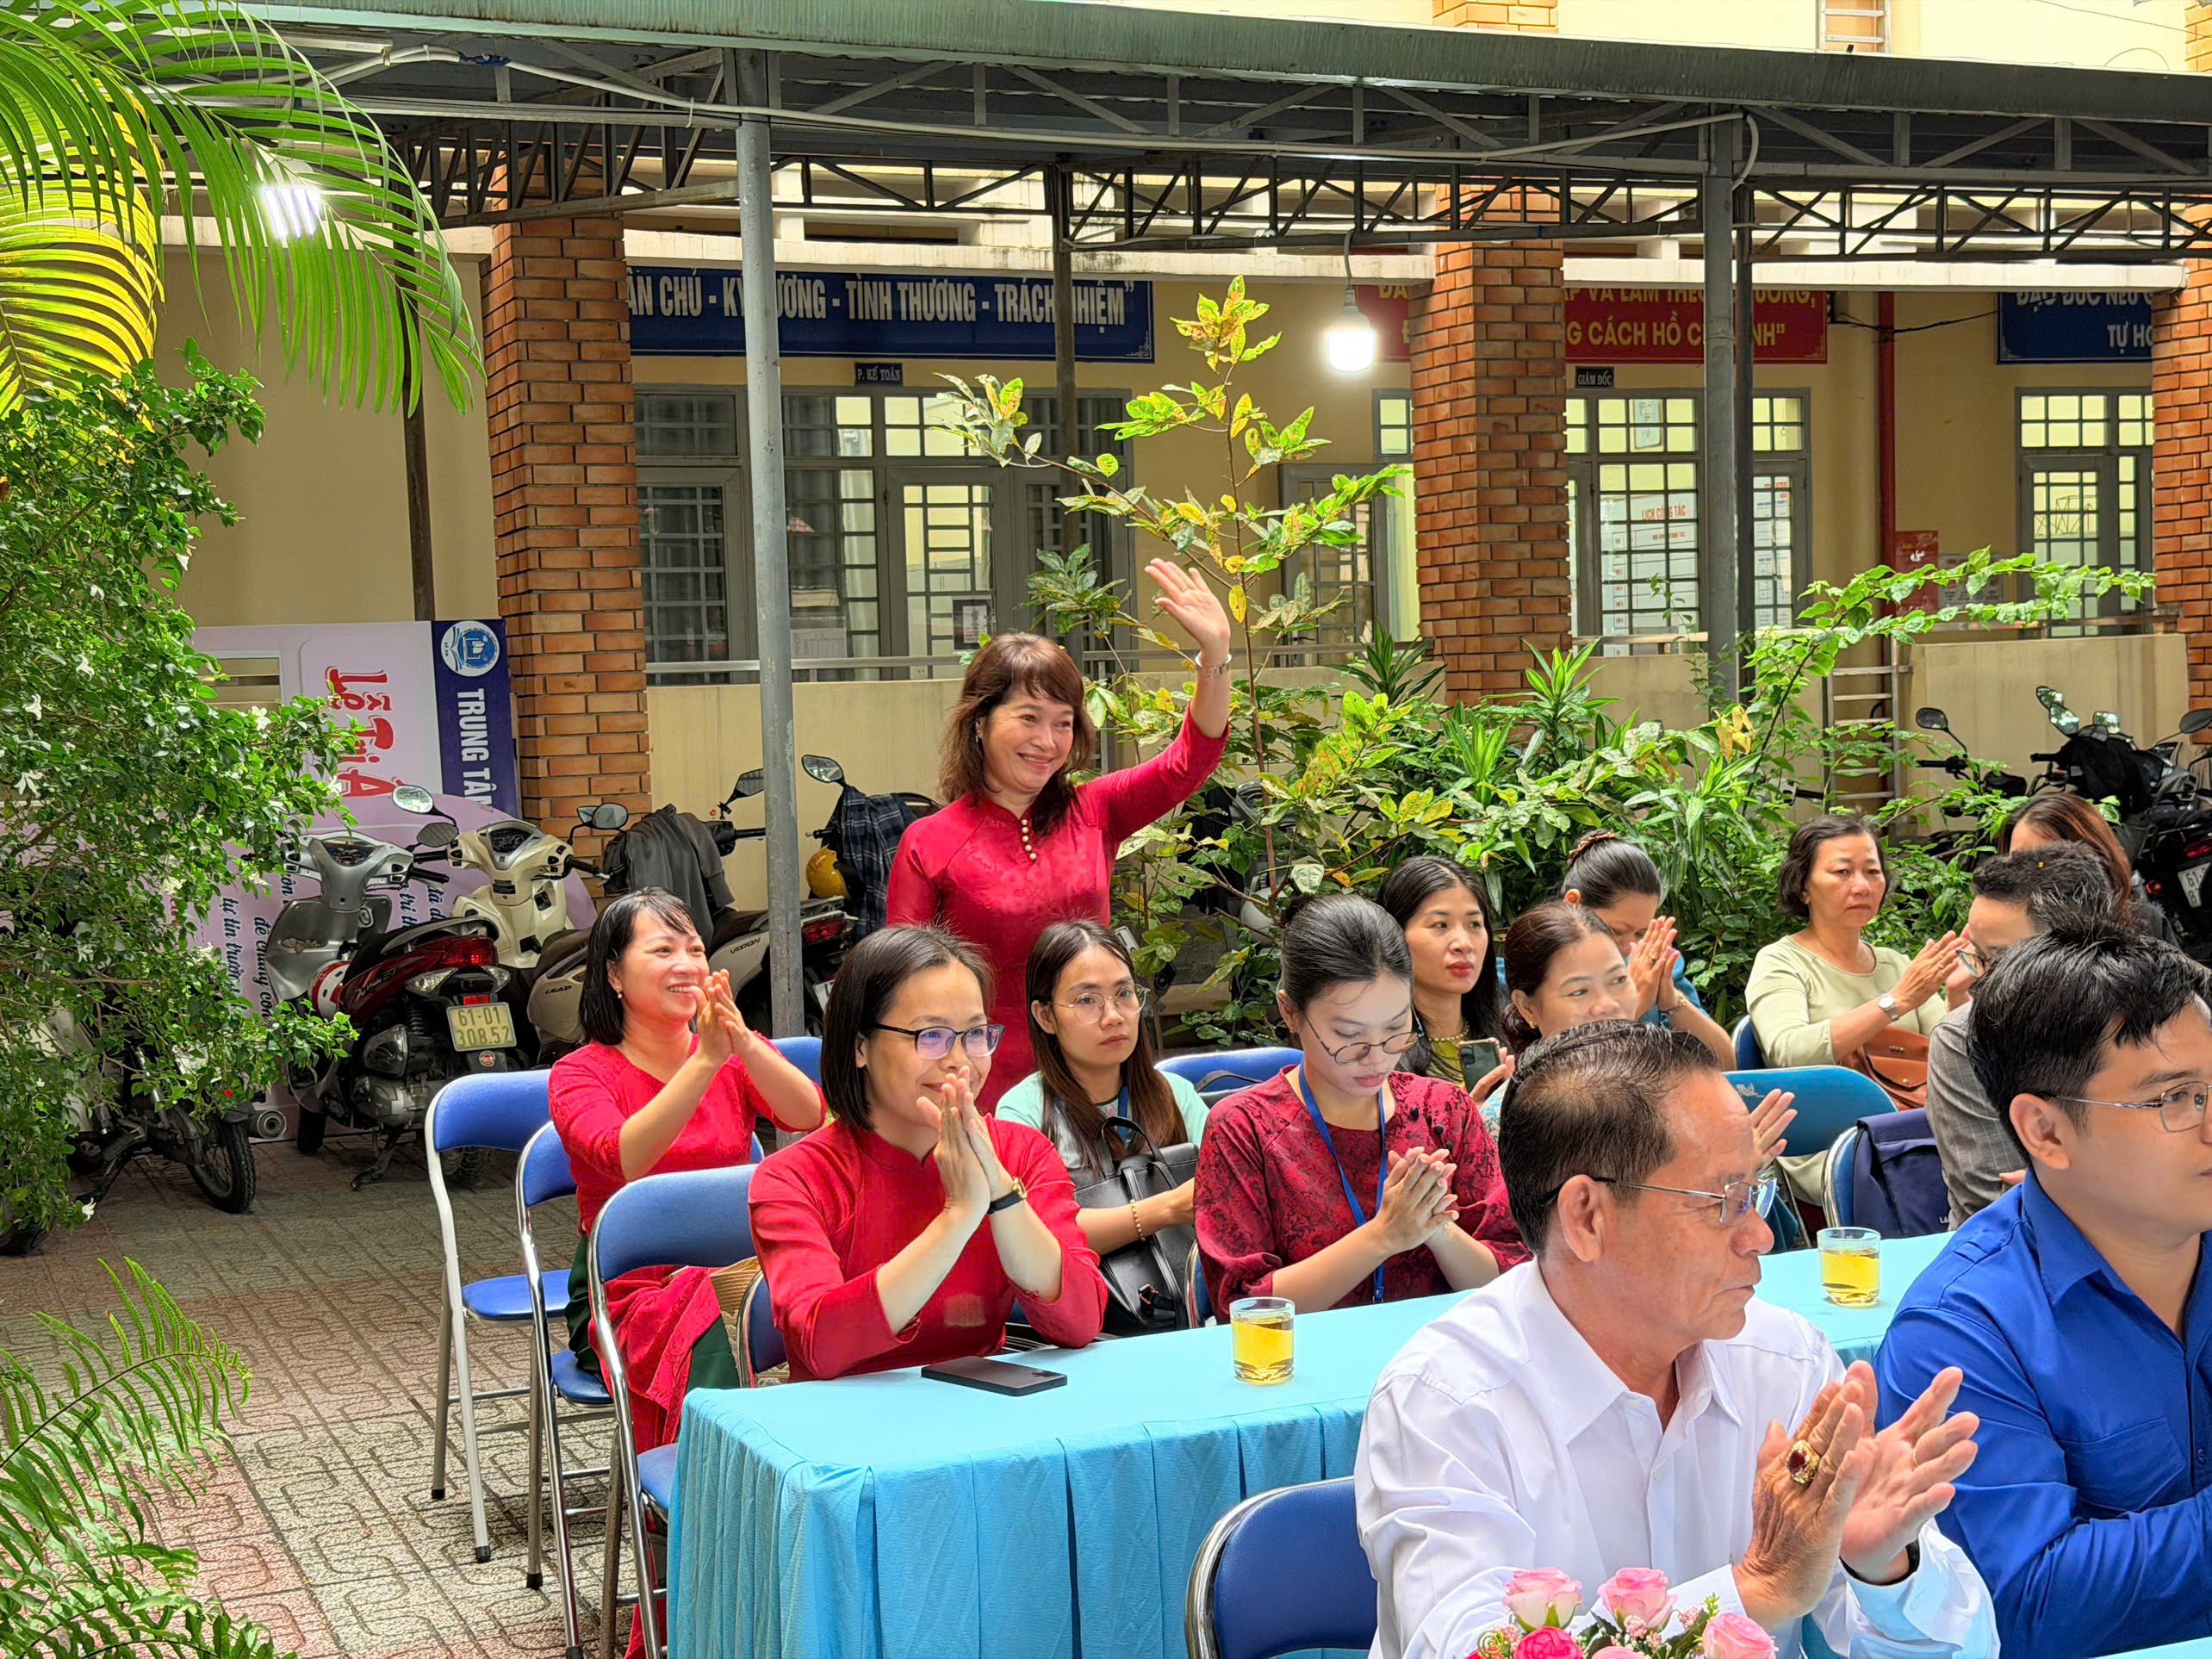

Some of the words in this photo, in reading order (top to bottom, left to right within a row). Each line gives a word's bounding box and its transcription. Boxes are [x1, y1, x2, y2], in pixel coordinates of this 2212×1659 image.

[845, 273, 892, 320] TÌNH
[897, 278, 976, 322] THƯƠNG
[995, 277, 1055, 323] TRÁCH
[1588, 315, 1646, 345] CÁCH
[1652, 310, 1681, 346] HỒ
[2107, 320, 2129, 355] TỰ
[457, 688, 490, 762] TRUNG
[223, 916, 241, 940] tin
[730, 936, 761, 954] VISION
[544, 985, 573, 995] LEAD
[457, 1006, 502, 1027] 61-D1
[456, 1026, 513, 1048] 308.52
